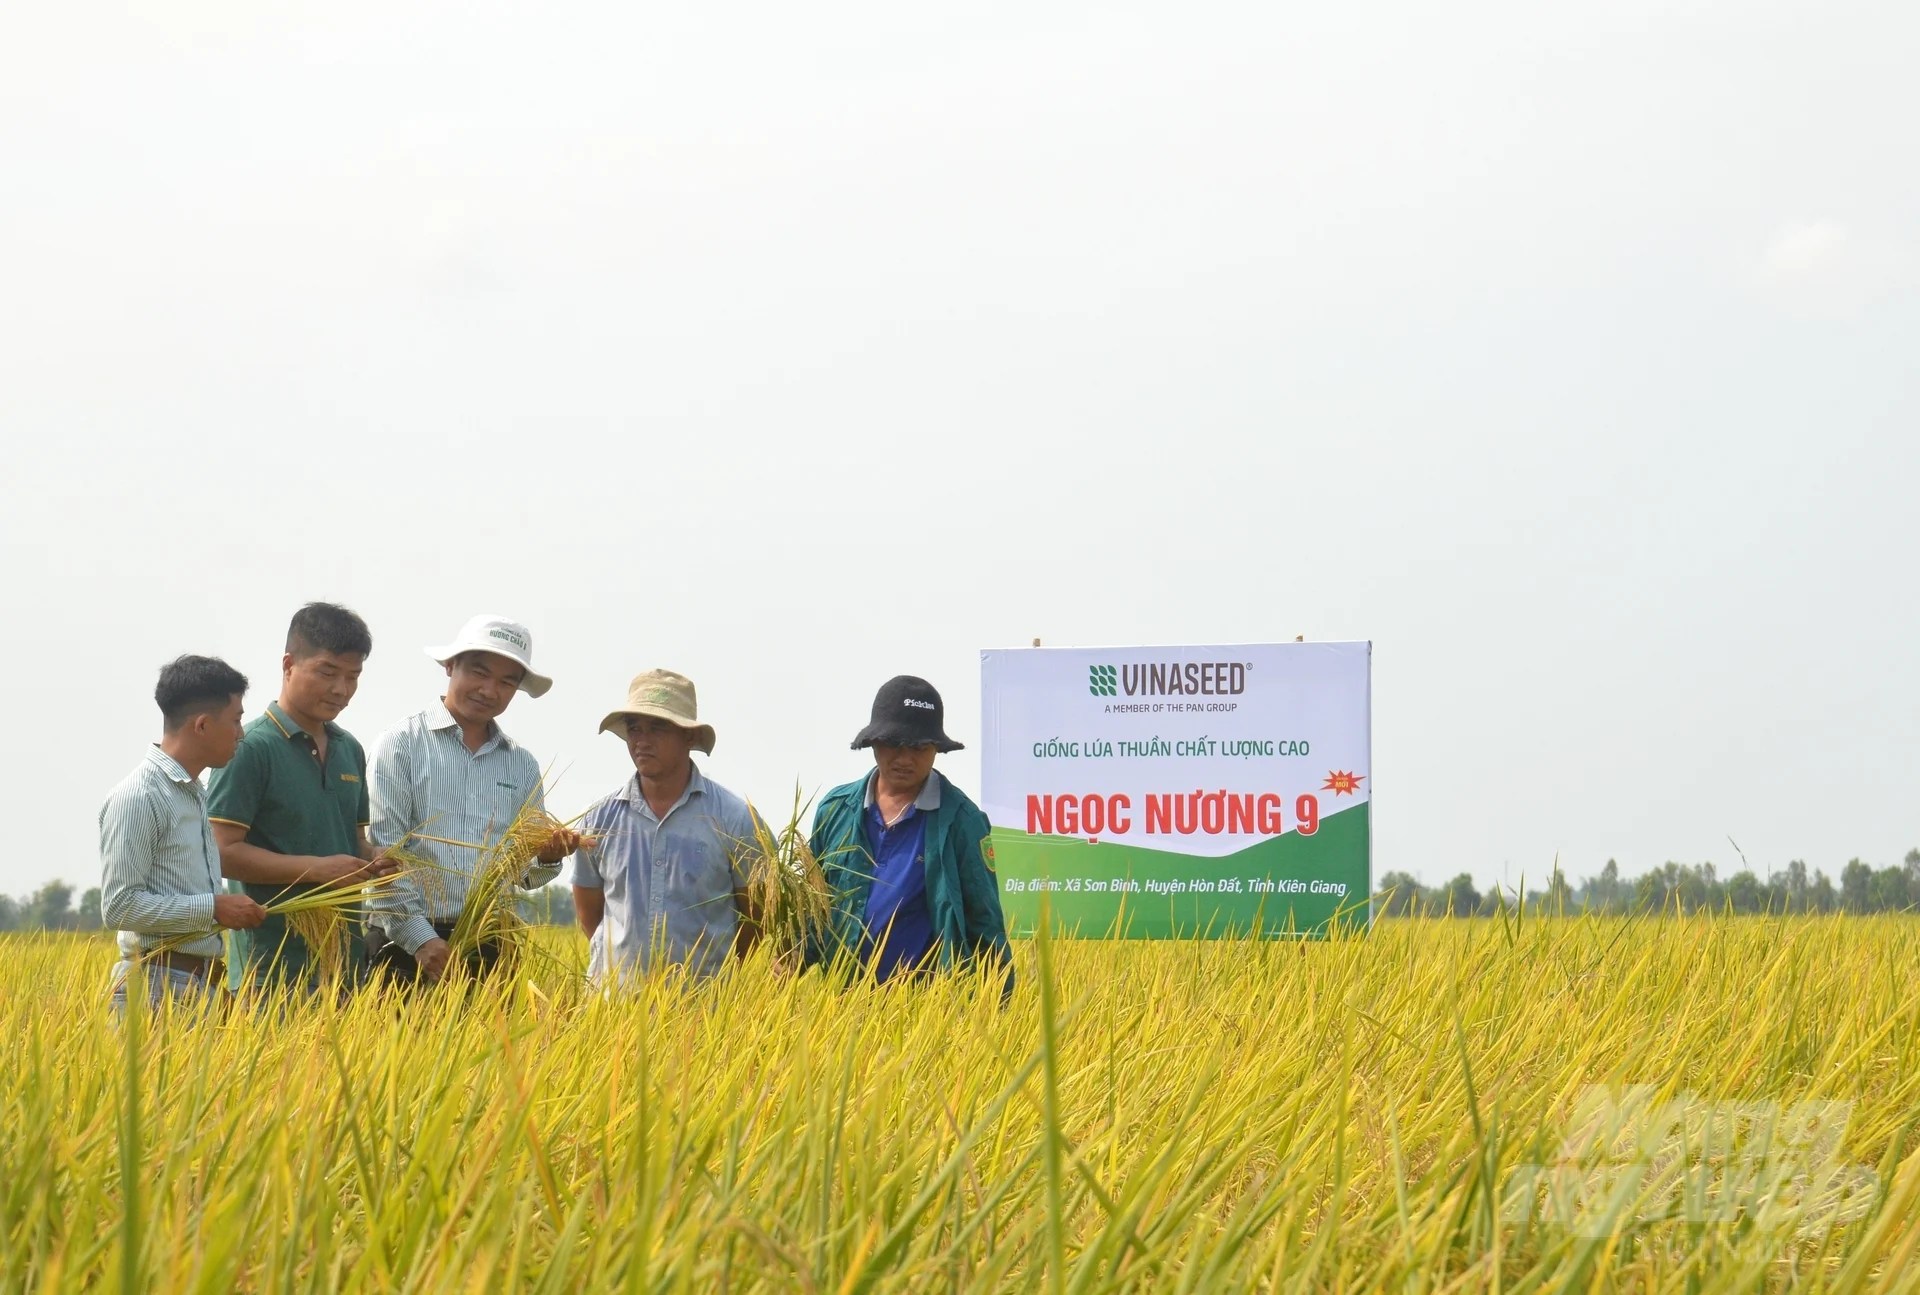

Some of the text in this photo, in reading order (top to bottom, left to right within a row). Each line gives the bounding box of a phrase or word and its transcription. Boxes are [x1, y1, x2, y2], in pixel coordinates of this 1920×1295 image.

[1122, 662, 1245, 696] VINASEED
[1104, 703, 1238, 714] A MEMBER OF THE PAN GROUP
[1033, 735, 1310, 760] GIỐNG LÚA THUẦN CHẤT LƯỢNG CAO
[1026, 789, 1319, 844] NGỌC NƯƠNG 9
[1005, 878, 1025, 895] Địa
[1064, 878, 1082, 892] Xã
[1084, 878, 1107, 892] Sơn
[1110, 878, 1141, 893] Bình,
[1145, 879, 1186, 896] Huyện
[1189, 879, 1214, 892] Hòn
[1218, 877, 1243, 894] Đất,
[1248, 877, 1274, 893] Tỉnh
[1278, 879, 1306, 893] Kiên
[1310, 880, 1347, 897] Giang
